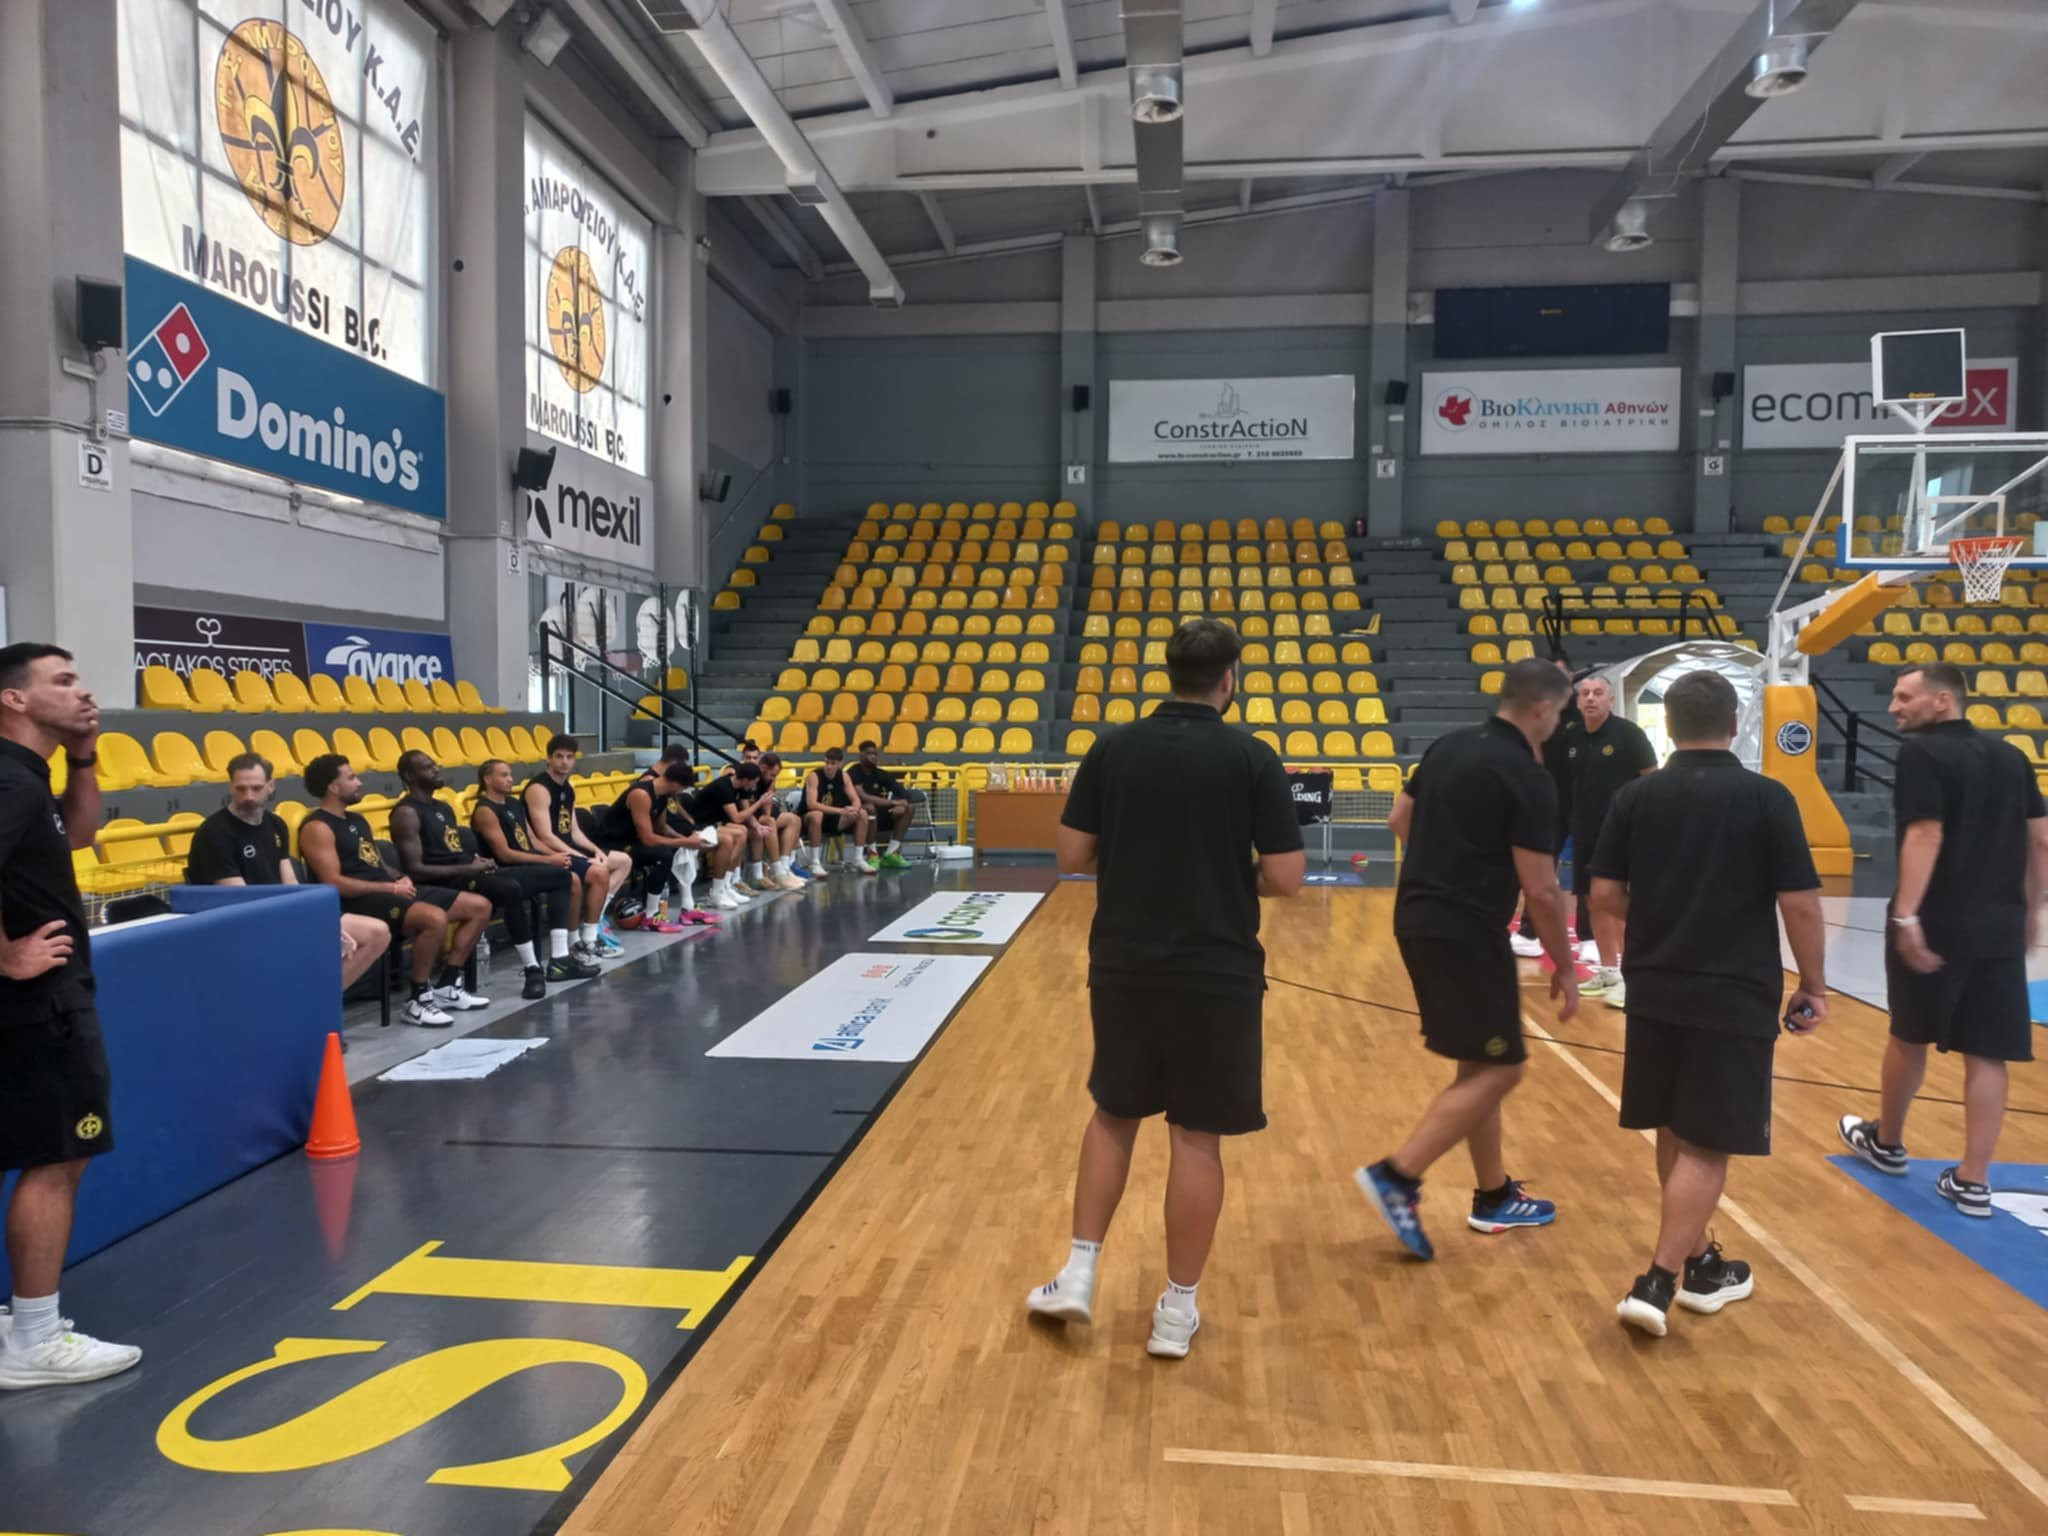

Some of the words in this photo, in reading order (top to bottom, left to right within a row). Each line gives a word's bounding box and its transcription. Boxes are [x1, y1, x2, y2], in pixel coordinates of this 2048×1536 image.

[182, 223, 330, 335] MAROUSSI
[530, 393, 598, 451] MAROUSSI
[1604, 401, 1669, 415] Αθηνών
[216, 366, 421, 491] Domino's
[1153, 417, 1308, 440] ConstrActioN
[87, 453, 103, 475] D
[558, 483, 641, 546] mexil
[228, 656, 293, 681] STORES
[348, 651, 442, 685] avance
